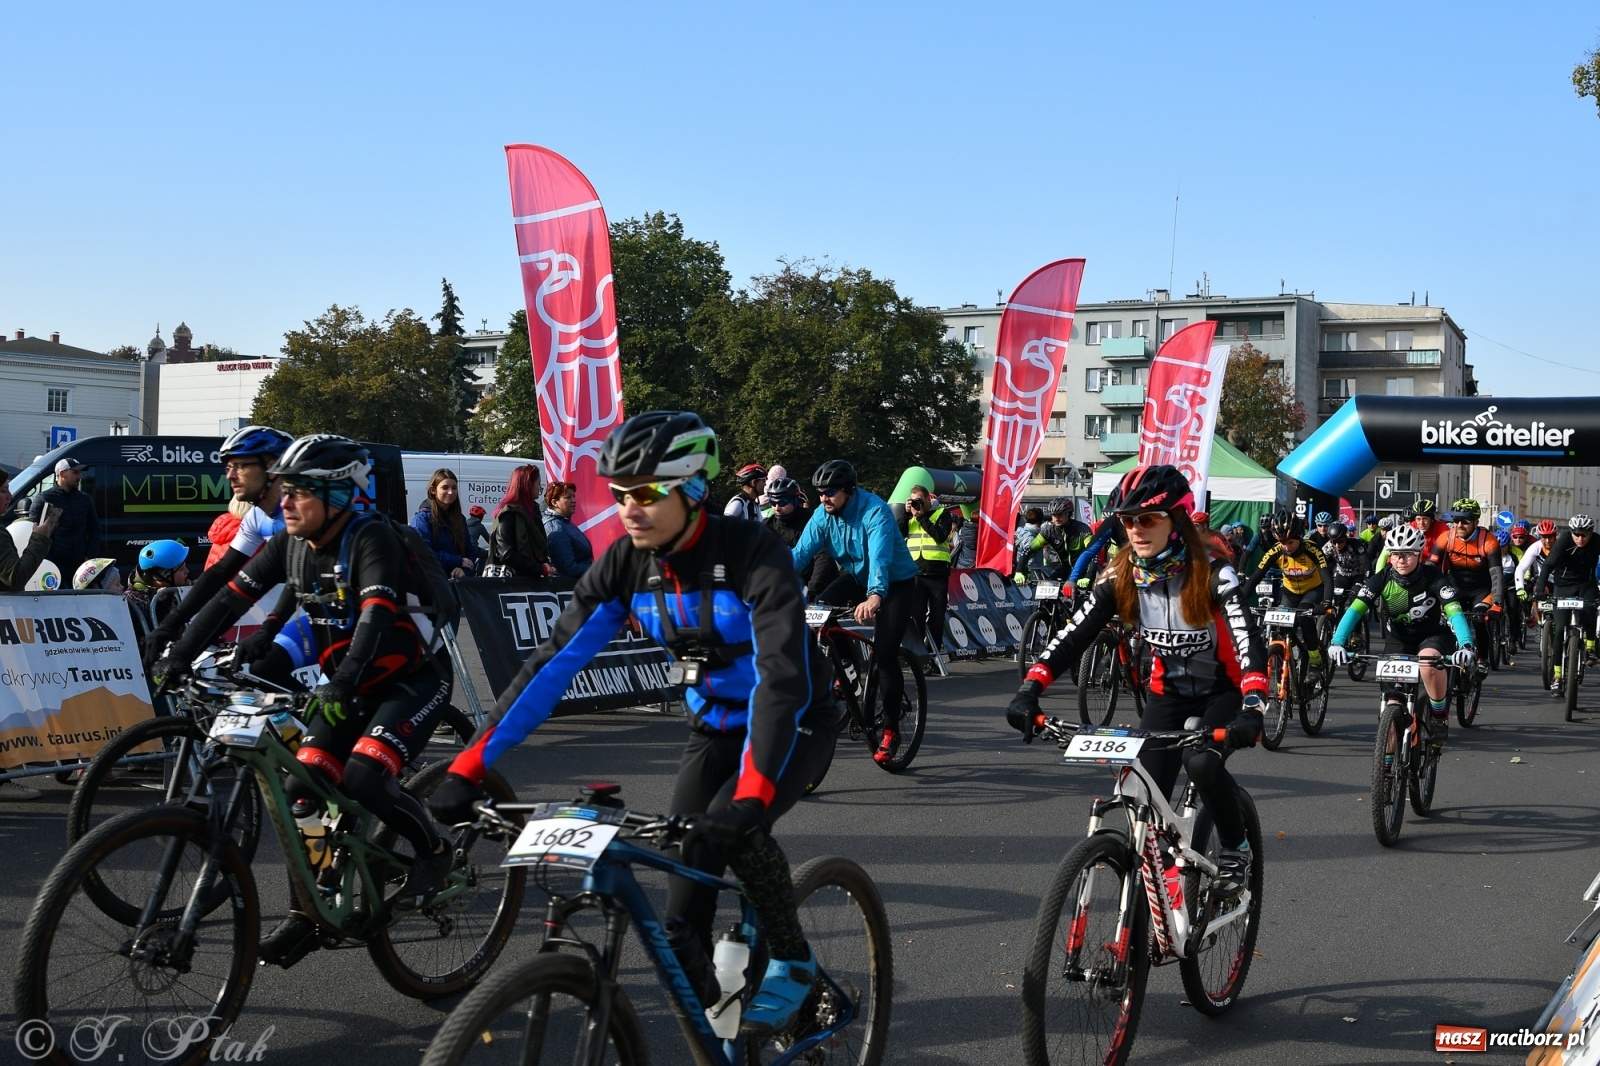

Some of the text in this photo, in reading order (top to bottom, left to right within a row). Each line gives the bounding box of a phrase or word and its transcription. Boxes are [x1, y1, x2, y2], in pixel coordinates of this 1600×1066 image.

[217, 363, 237, 372] BLACK
[252, 362, 272, 370] WHITE
[1421, 420, 1574, 446] bike atelier
[162, 445, 204, 464] bike
[1143, 630, 1208, 646] STEVENS
[45, 646, 122, 656] gdziekolwiek jedziesz
[1384, 664, 1412, 674] 2143
[1080, 740, 1127, 752] 3186
[530, 828, 593, 848] 1602
